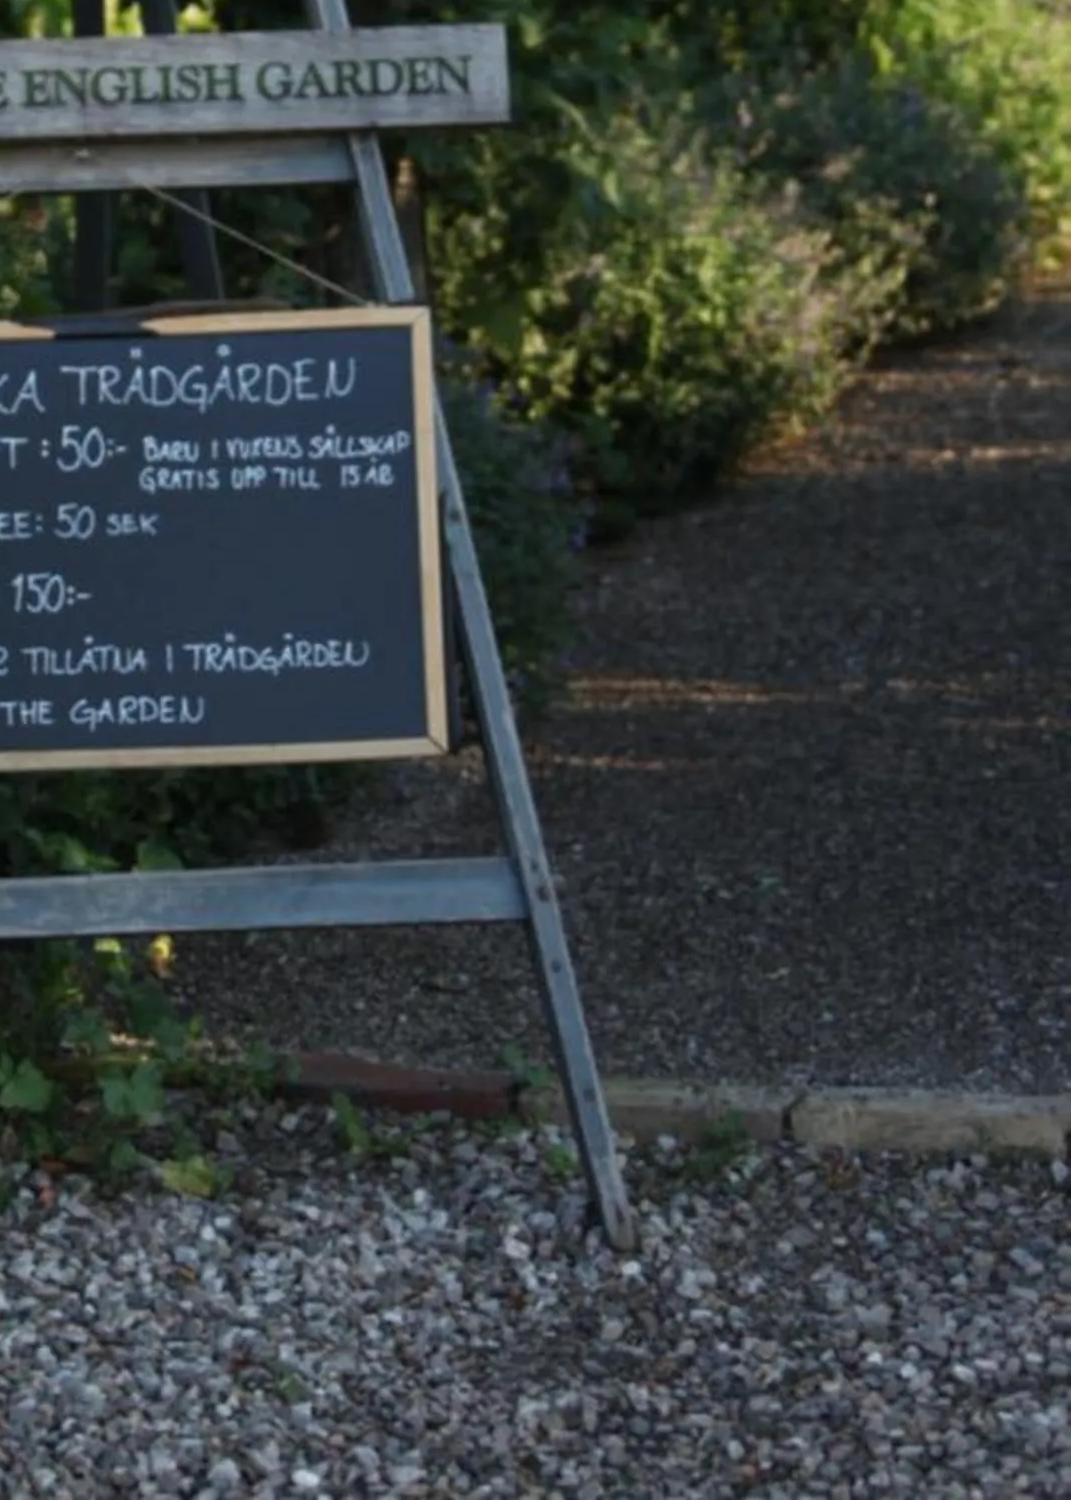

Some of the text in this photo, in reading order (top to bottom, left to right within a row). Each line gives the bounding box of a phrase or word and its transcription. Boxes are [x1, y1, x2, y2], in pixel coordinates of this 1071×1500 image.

[21, 62, 241, 106] ENGLISH
[255, 55, 472, 99] GARDEN
[60, 344, 357, 414] TRÄDGÅRDEN
[139, 466, 220, 495] GRATIS
[231, 466, 268, 490] UPP
[273, 466, 321, 490] TILL
[53, 503, 96, 540] 50
[105, 513, 160, 536] SEK
[68, 695, 206, 733] GARDEN
